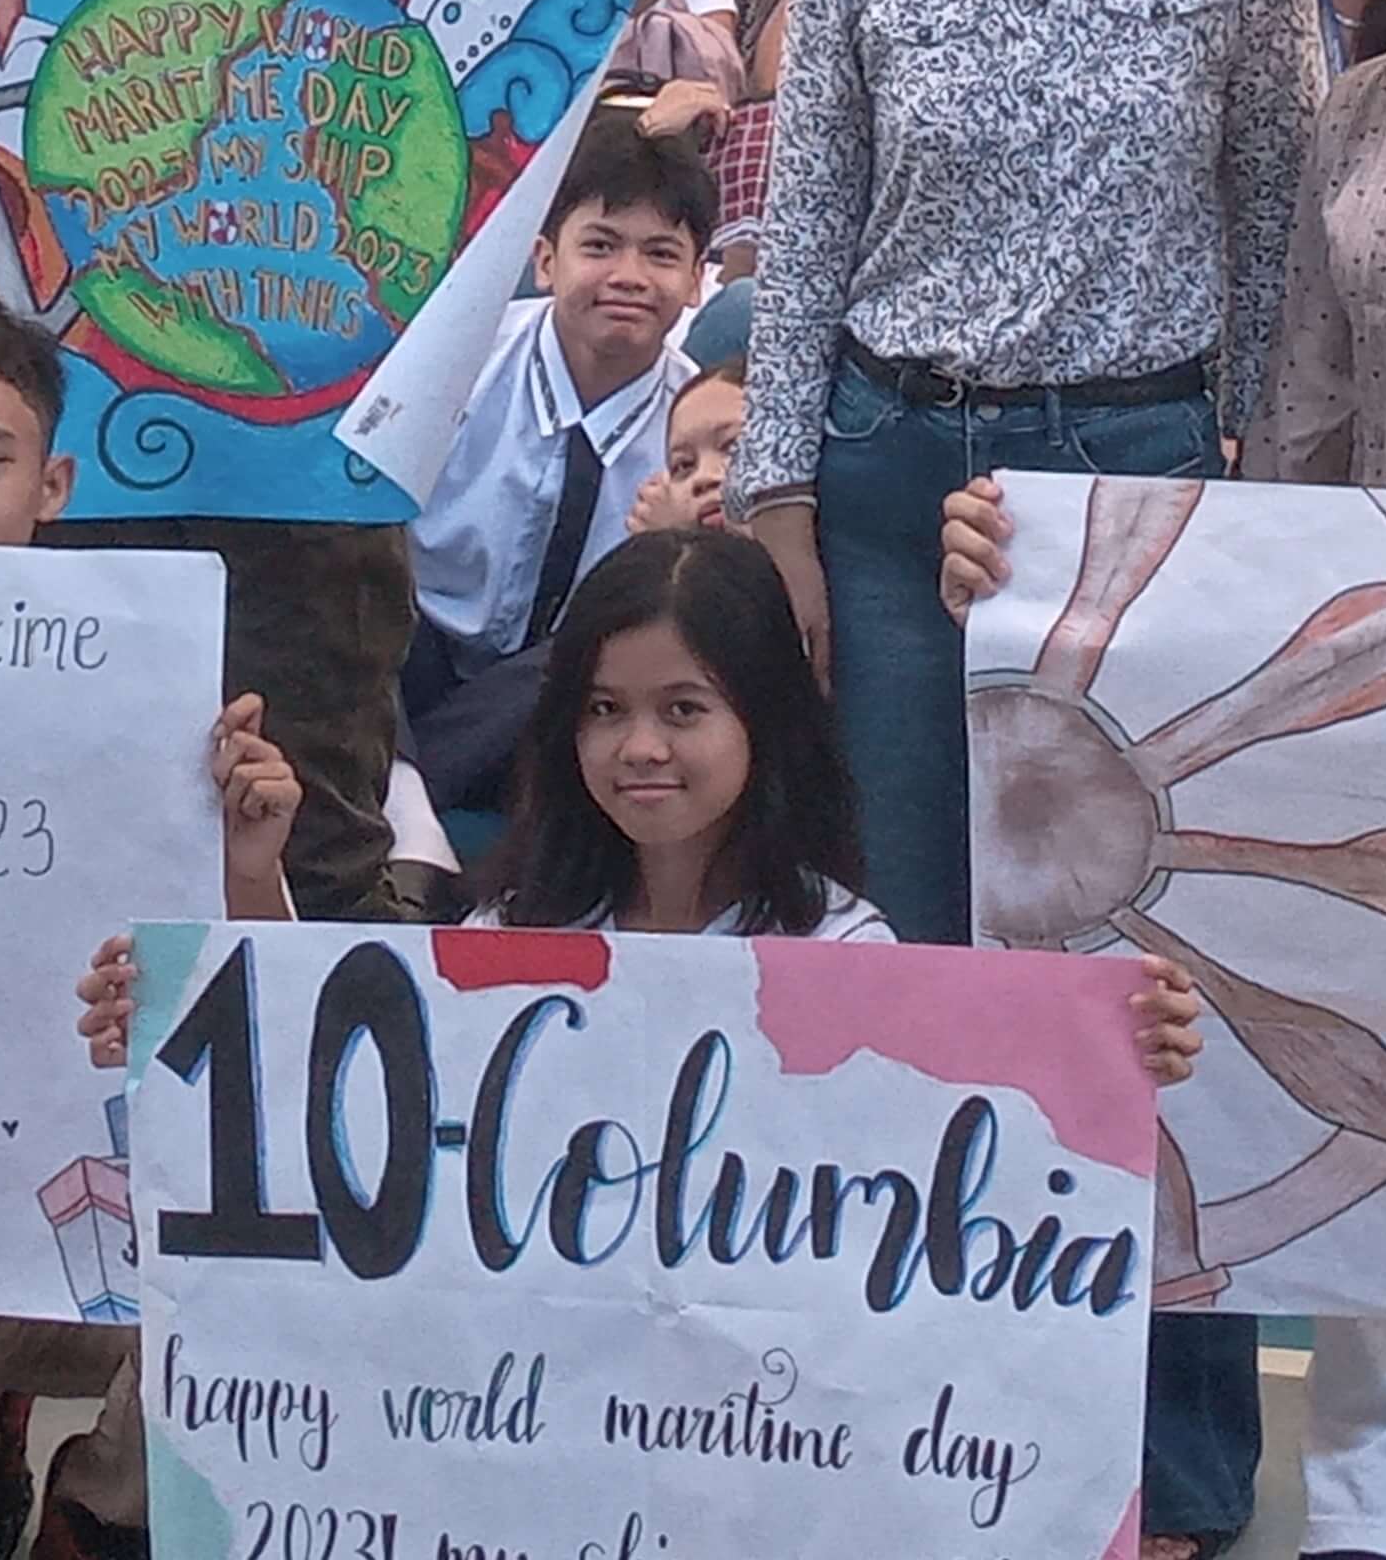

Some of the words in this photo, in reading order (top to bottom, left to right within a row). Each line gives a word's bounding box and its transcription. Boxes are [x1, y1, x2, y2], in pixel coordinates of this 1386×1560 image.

[61, 0, 246, 81] HAPPY
[303, 66, 412, 137] DAY
[68, 147, 197, 232] 2023
[210, 134, 266, 187] MY
[280, 129, 394, 200] SHIP
[95, 206, 161, 283] MY
[330, 216, 435, 294] 2023
[253, 267, 365, 339] TNHS
[159, 1333, 339, 1471] happy
[380, 1349, 546, 1446] world
[602, 1346, 855, 1472] maritime
[902, 1383, 1042, 1530] day
